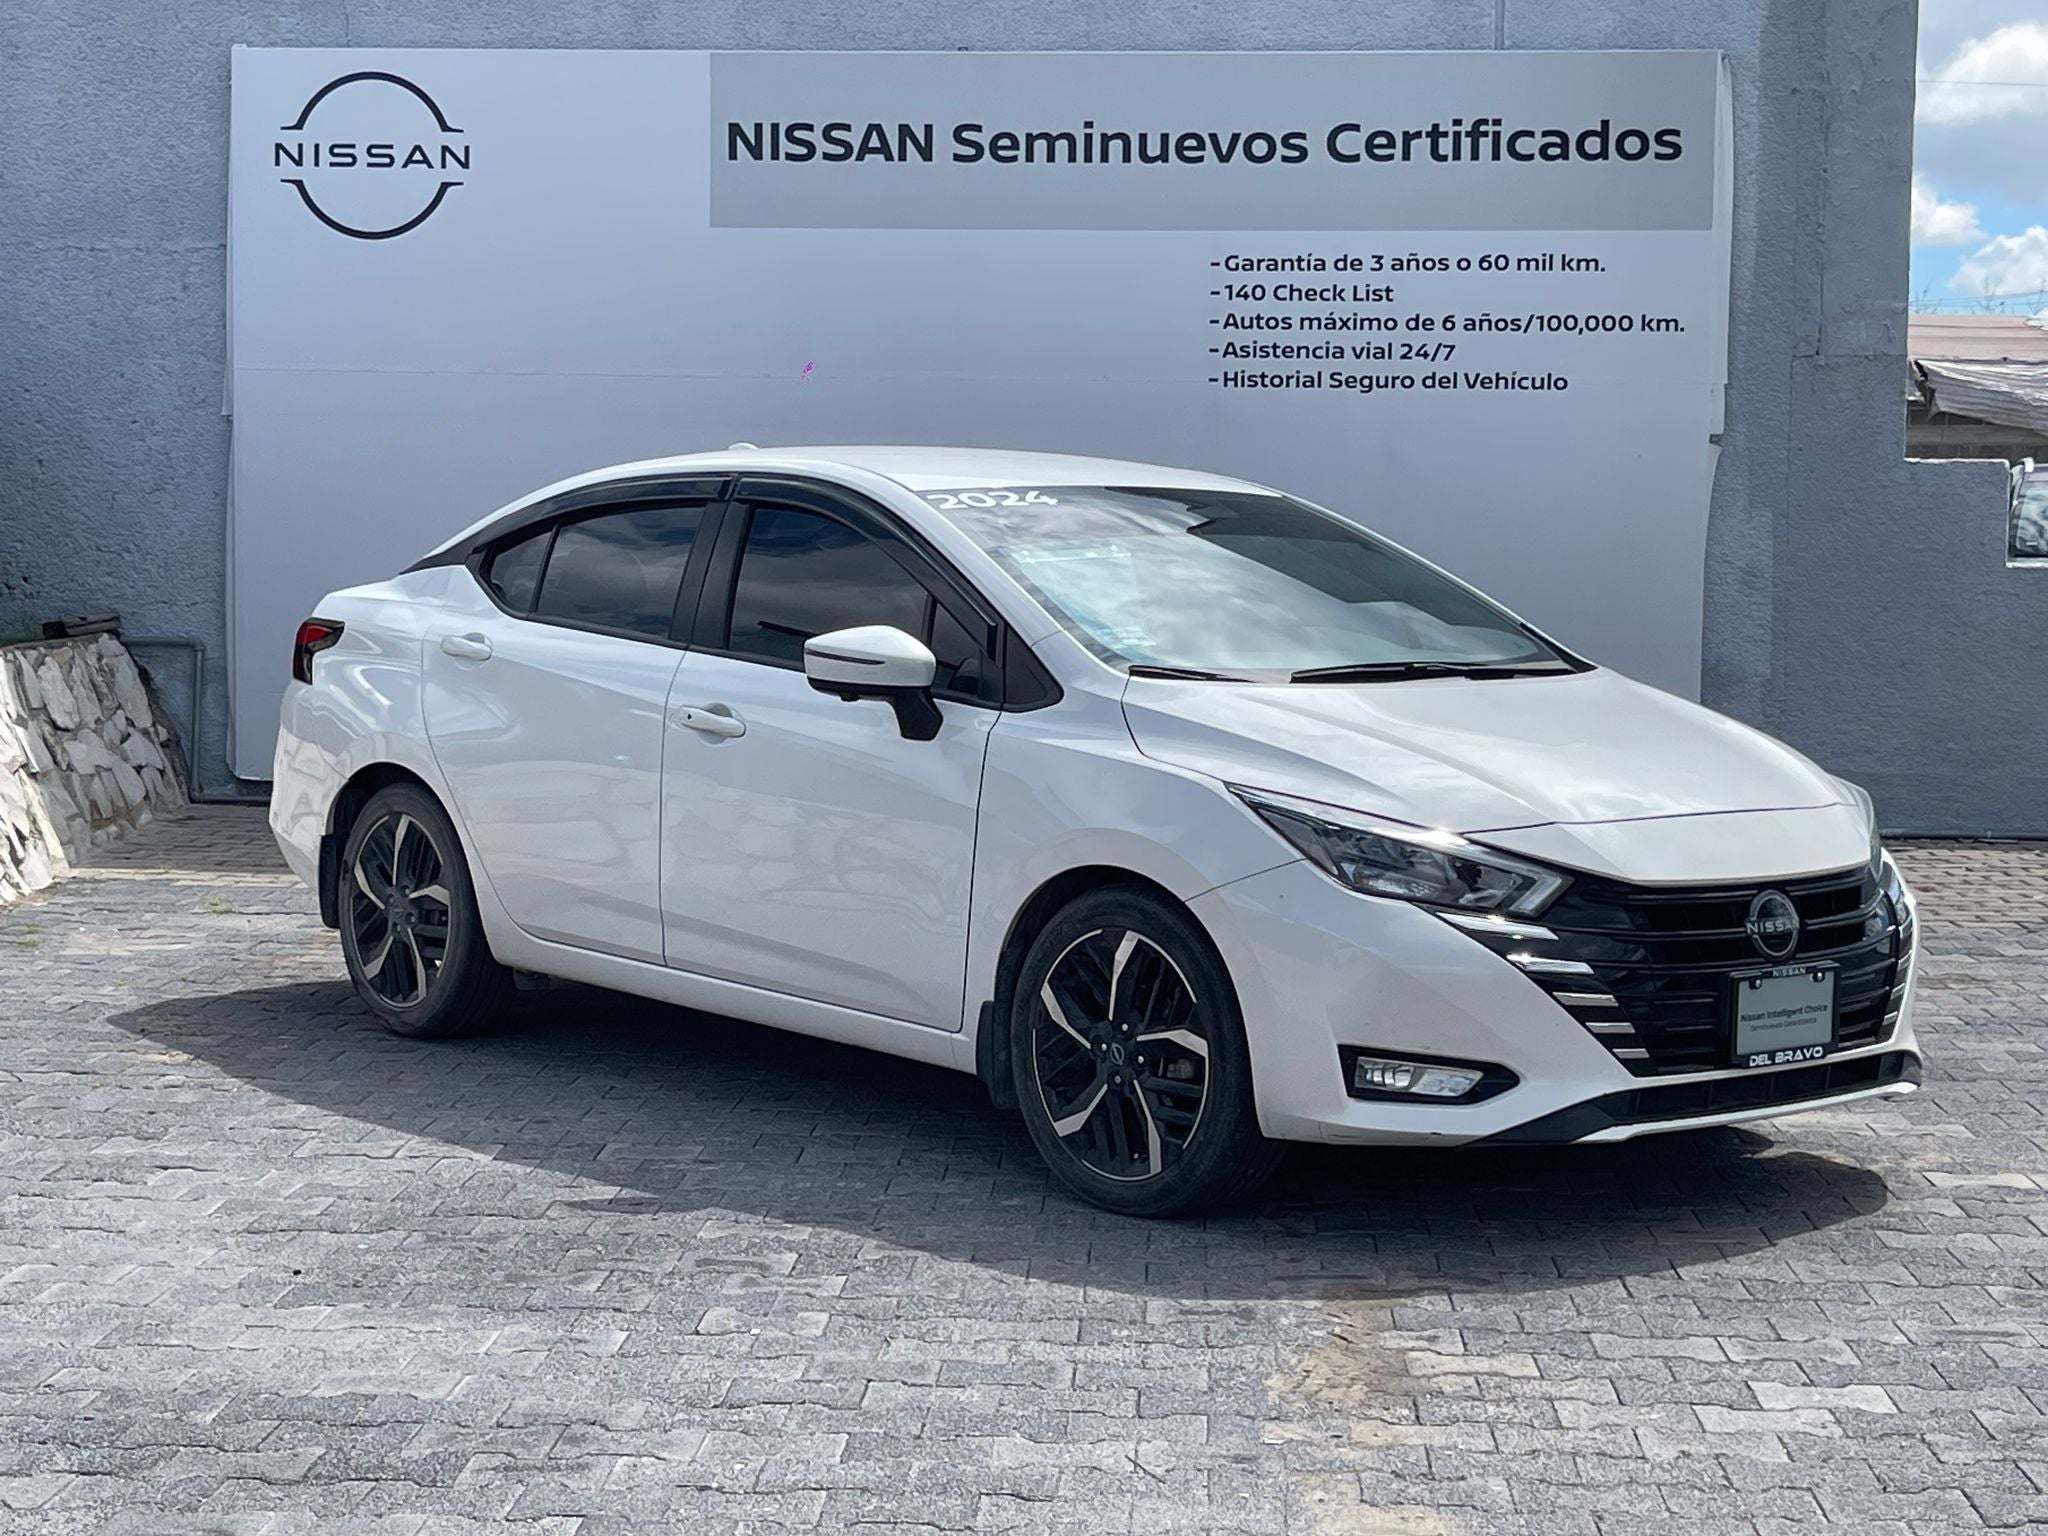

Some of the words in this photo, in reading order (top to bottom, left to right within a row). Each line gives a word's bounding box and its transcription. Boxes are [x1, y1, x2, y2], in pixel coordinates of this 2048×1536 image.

[727, 122, 934, 163] NISSAN
[952, 120, 1309, 165] Seminuevos
[1326, 118, 1683, 164] Certificados
[274, 142, 470, 169] NISSAN
[1333, 253, 1364, 272] de
[1369, 254, 1385, 272] 3
[1390, 252, 1450, 272] años
[1456, 257, 1472, 272] o
[1478, 253, 1510, 272] 60
[1516, 252, 1554, 272] mil
[1561, 253, 1606, 273] km.
[1272, 283, 1346, 303] Check
[1352, 283, 1395, 303] List
[1299, 311, 1399, 332] máximo
[1405, 313, 1436, 332] de
[1441, 314, 1456, 332] 6
[1462, 312, 1634, 336] años/100,000
[1640, 313, 1685, 333] km.
[1351, 341, 1393, 360] vial
[1399, 342, 1456, 363] 24/7
[1328, 371, 1416, 394] Seguro
[1421, 371, 1458, 390] del
[1463, 370, 1569, 391] Vehículo
[926, 490, 1058, 510] 2024
[1772, 967, 1806, 977] NISSAN
[1749, 1055, 1772, 1067] DEL
[1775, 1046, 1823, 1064] BRAVO
